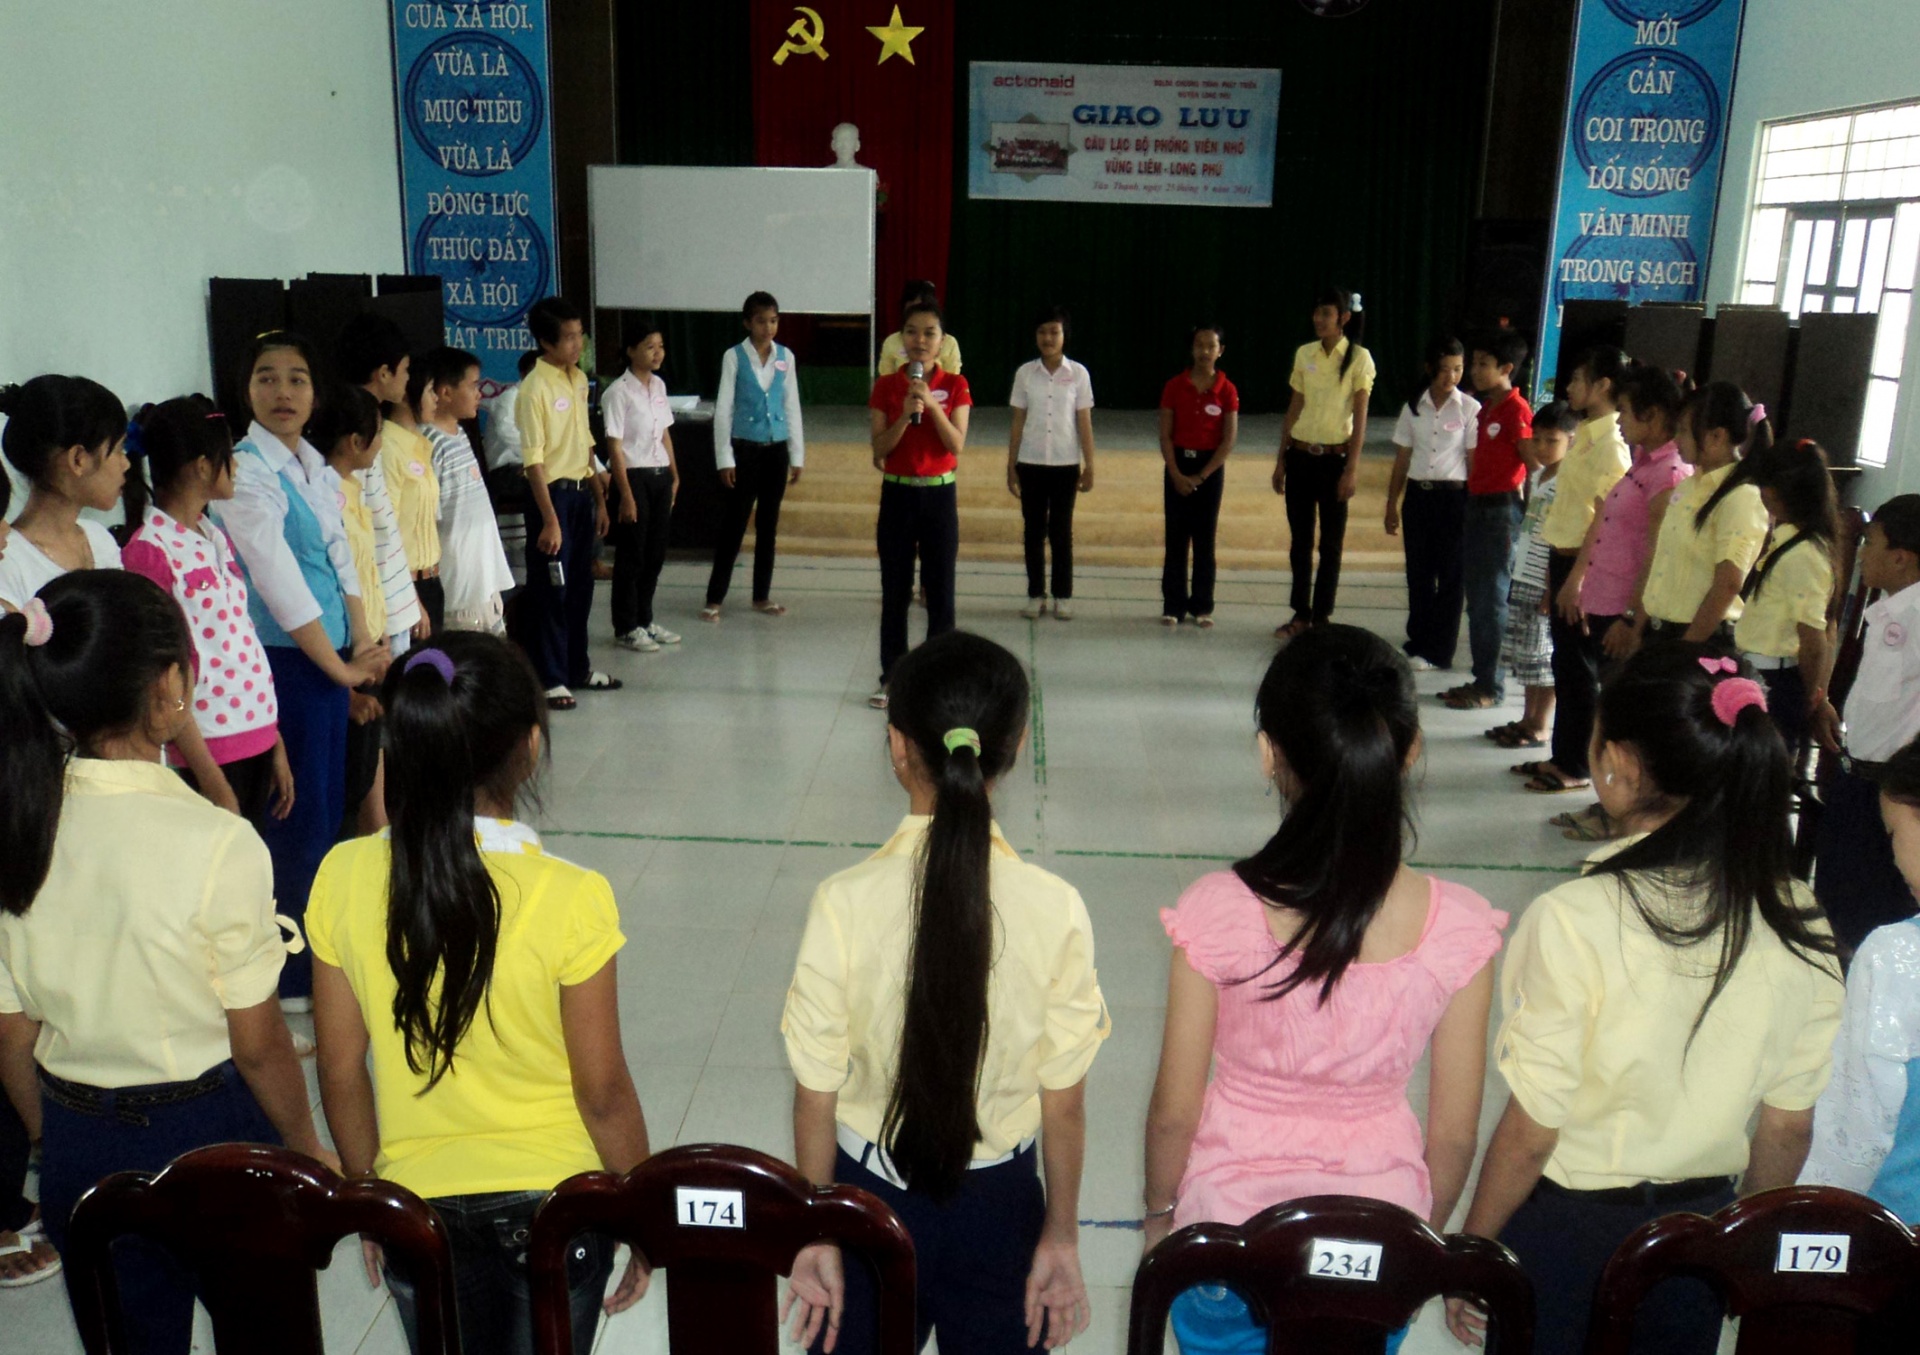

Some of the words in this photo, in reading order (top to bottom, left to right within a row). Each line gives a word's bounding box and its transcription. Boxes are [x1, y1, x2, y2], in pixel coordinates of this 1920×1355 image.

[1634, 12, 1681, 46] MỚI
[433, 46, 476, 76] VỪA
[481, 46, 510, 76] LÀ
[1628, 56, 1676, 94] CẦN
[993, 74, 1075, 88] actionaid
[424, 99, 469, 129] MỤC
[473, 92, 523, 123] TIÊU
[1072, 104, 1162, 126] GIAO
[1178, 106, 1251, 128] LƯU
[1586, 117, 1625, 142] COI
[1630, 118, 1706, 149] TRỌNG
[438, 140, 481, 170] VỪA
[486, 140, 513, 170] LÀ
[1587, 154, 1626, 190] LỐI
[1630, 155, 1691, 191] SỐNG
[427, 184, 485, 220] ĐỘNG
[491, 190, 529, 222] LỰC
[1579, 207, 1626, 237] VĂN
[1629, 213, 1691, 238] MINH
[428, 231, 483, 261] THÚC
[488, 223, 531, 262] ĐẨY
[1560, 258, 1635, 284] TRONG
[1638, 260, 1697, 290] SẠCH
[446, 277, 476, 305] XÃ
[482, 276, 519, 312] HỘI
[686, 1200, 737, 1225] 174
[1316, 1251, 1372, 1278] 234
[1788, 1245, 1842, 1270] 179
